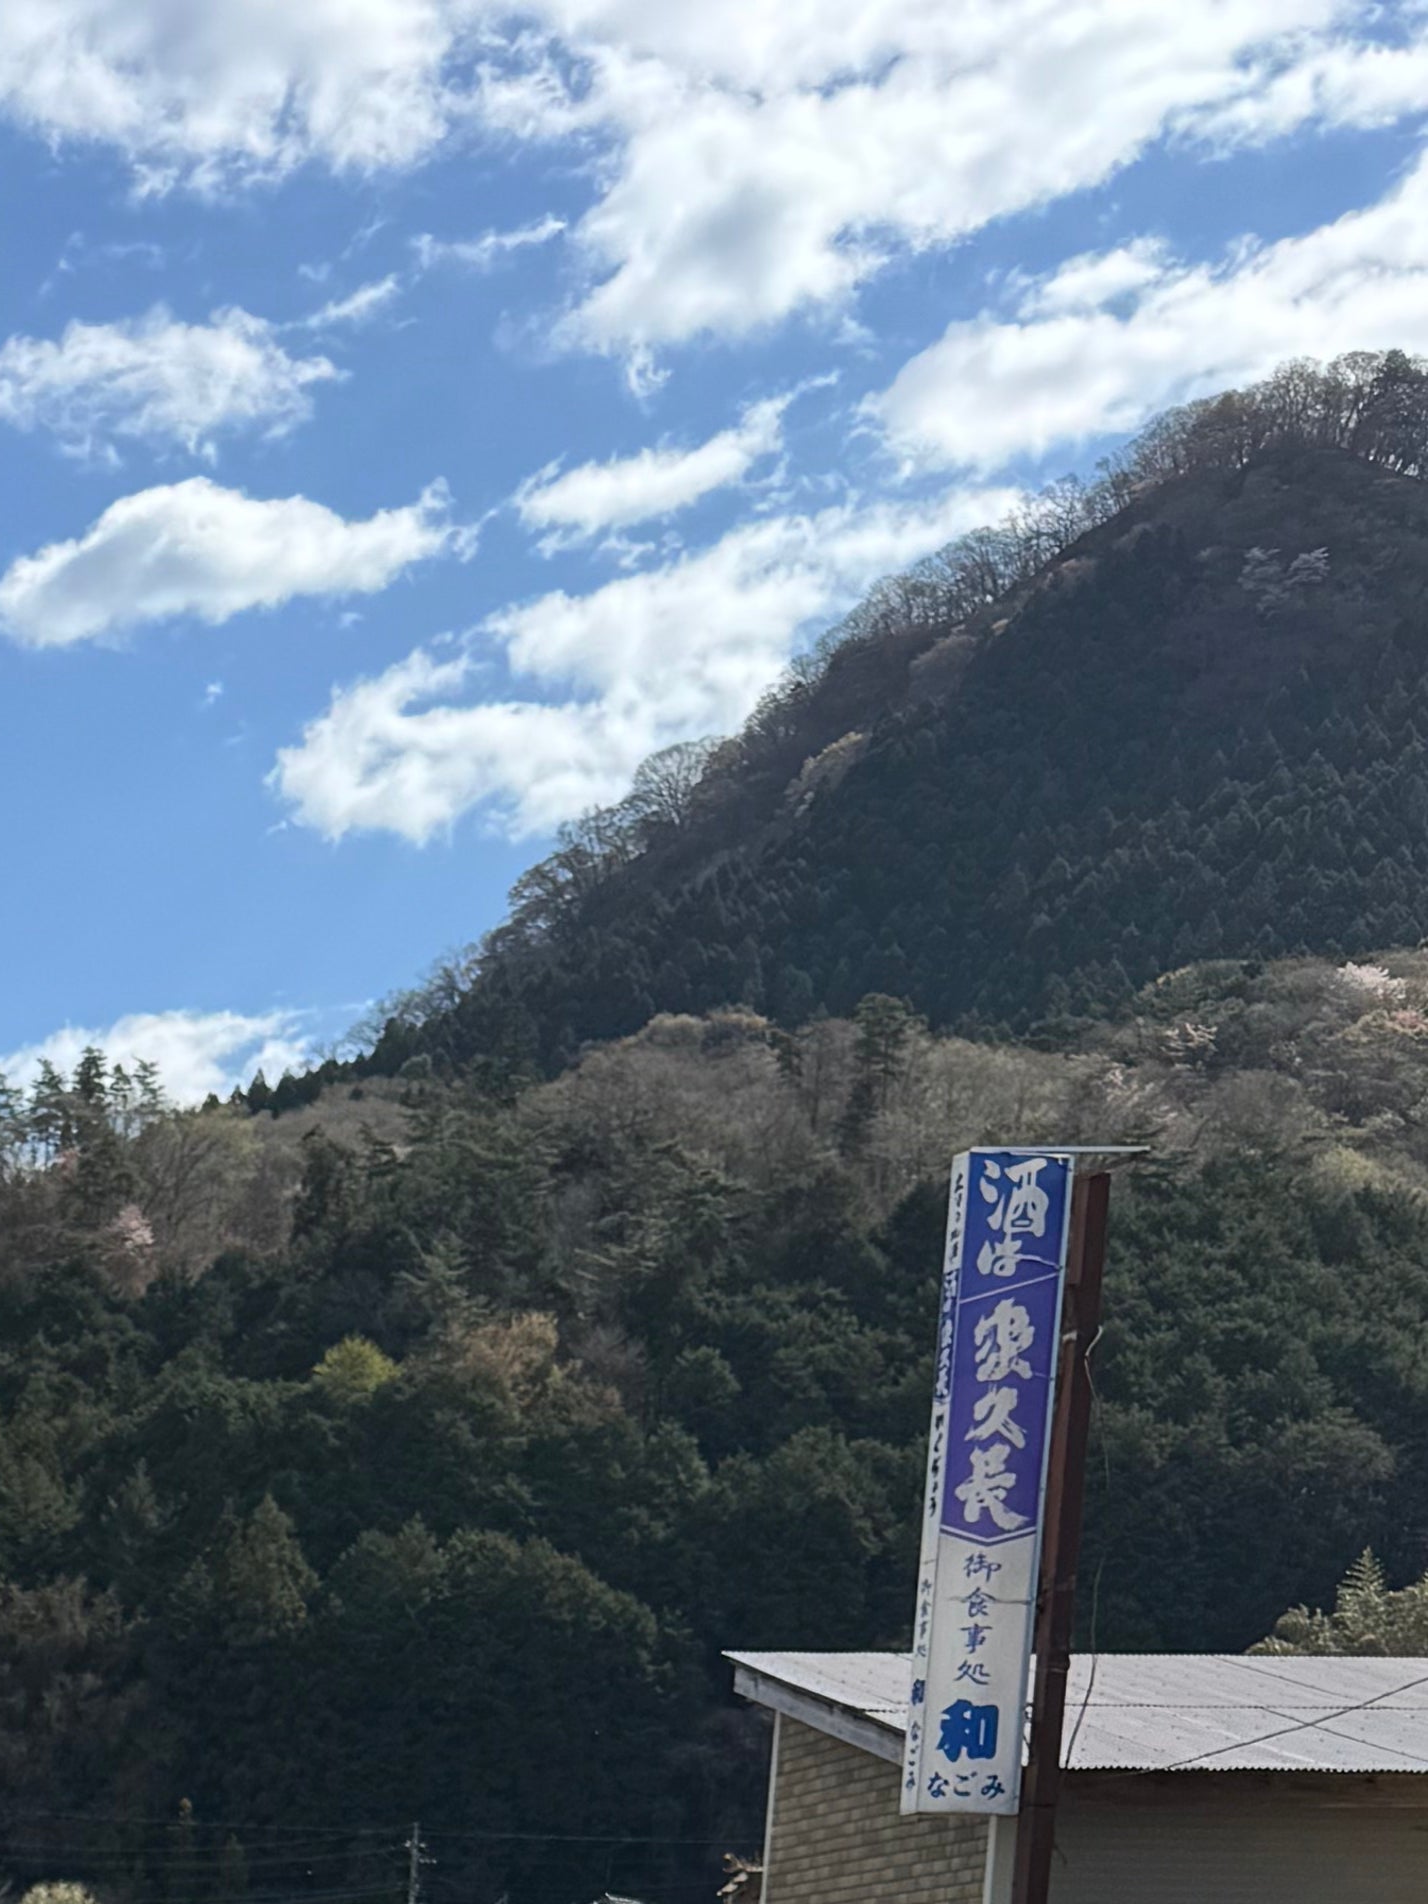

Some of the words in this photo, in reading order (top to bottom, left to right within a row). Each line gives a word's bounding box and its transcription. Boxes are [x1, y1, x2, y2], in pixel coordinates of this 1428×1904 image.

[975, 1158, 1049, 1278] 酒は
[953, 1553, 1003, 1686] 御食事処
[936, 1699, 1000, 1763] 和
[927, 1771, 1006, 1800] なごみ
